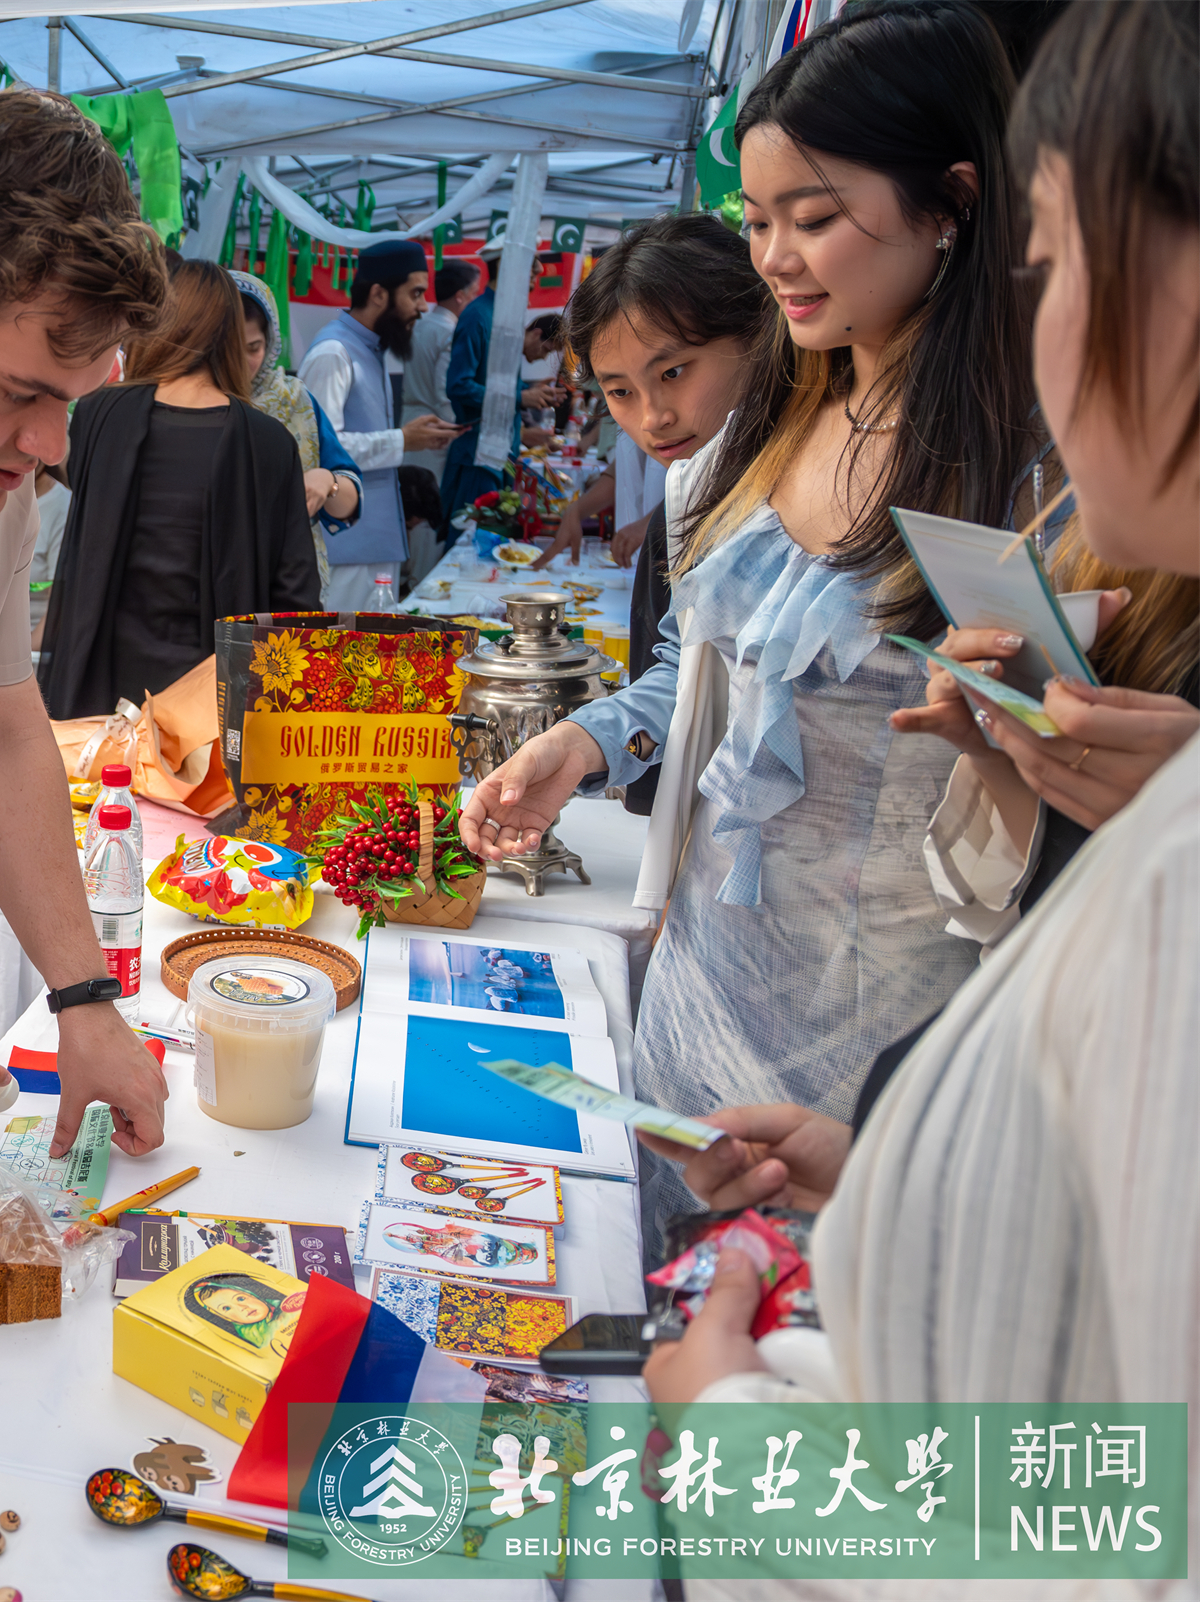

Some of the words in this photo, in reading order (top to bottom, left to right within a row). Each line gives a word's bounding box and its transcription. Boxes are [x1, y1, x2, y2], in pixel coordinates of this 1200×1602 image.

[280, 725, 361, 758] GOLDEN
[373, 726, 452, 759] RUSSIA
[320, 762, 408, 774] 俄罗斯贸易之家
[334, 1255, 342, 1264] 200
